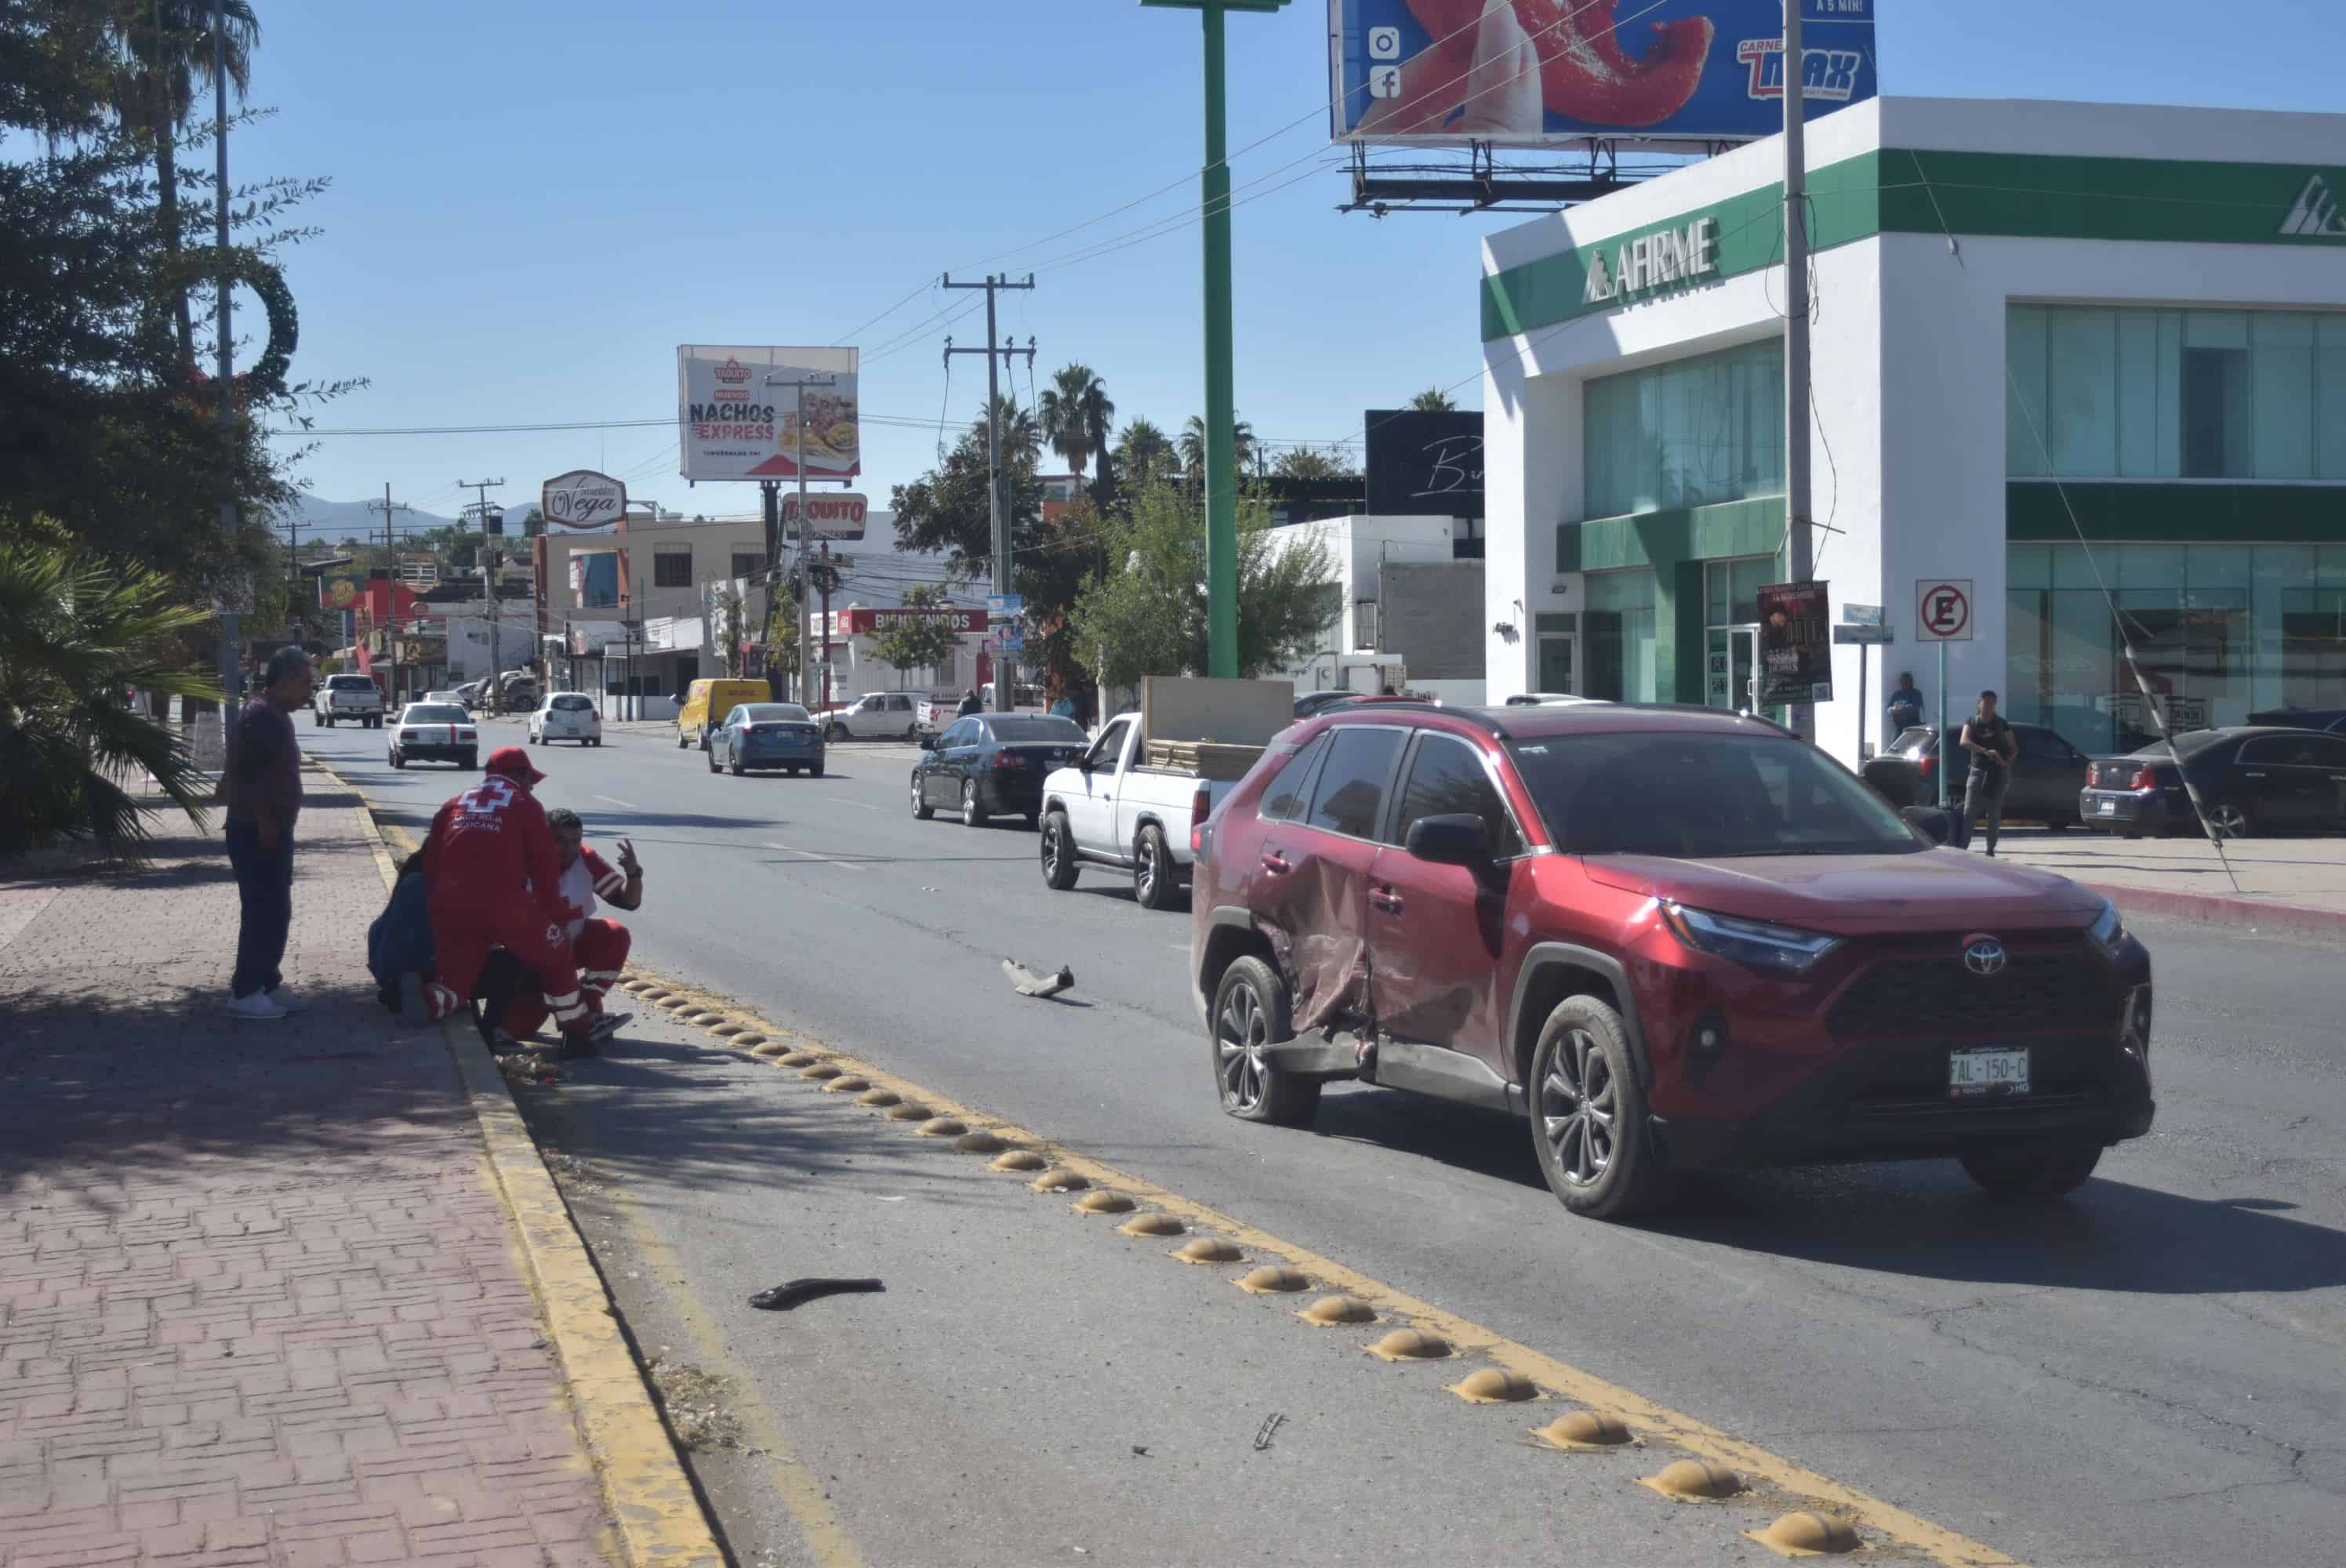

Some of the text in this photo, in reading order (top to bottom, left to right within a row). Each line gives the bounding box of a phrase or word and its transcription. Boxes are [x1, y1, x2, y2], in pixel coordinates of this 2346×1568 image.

[1614, 217, 1716, 295] AFIRME
[690, 404, 775, 423] NACHOS
[696, 424, 775, 440] EXPRESS
[552, 477, 616, 521] Vega
[1936, 597, 1954, 625] E
